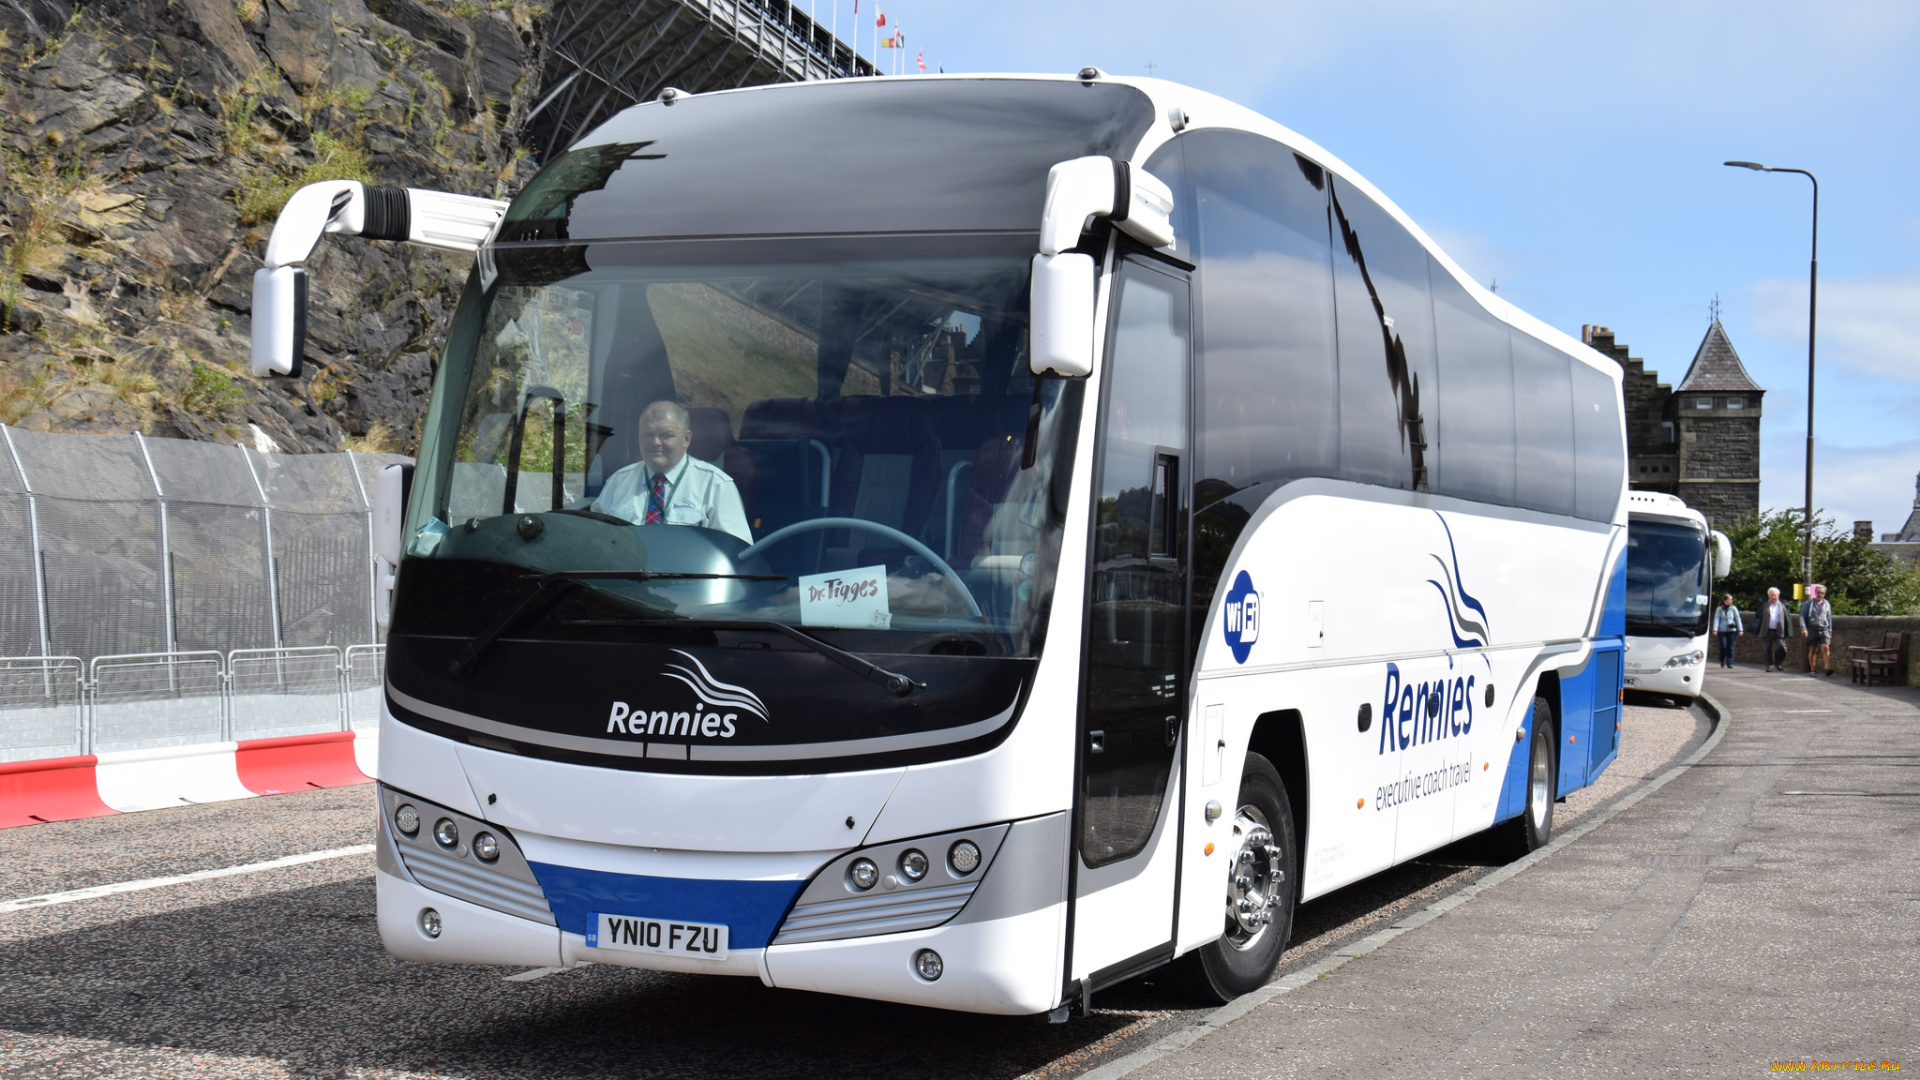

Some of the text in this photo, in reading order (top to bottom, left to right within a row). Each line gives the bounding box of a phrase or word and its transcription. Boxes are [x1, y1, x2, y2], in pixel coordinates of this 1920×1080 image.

[808, 578, 879, 607] Dr. Tigges
[606, 701, 738, 738] Rennies
[1379, 654, 1475, 756] Rennies
[1376, 751, 1472, 811] executive coach travel
[608, 917, 719, 954] YN10 FZU
